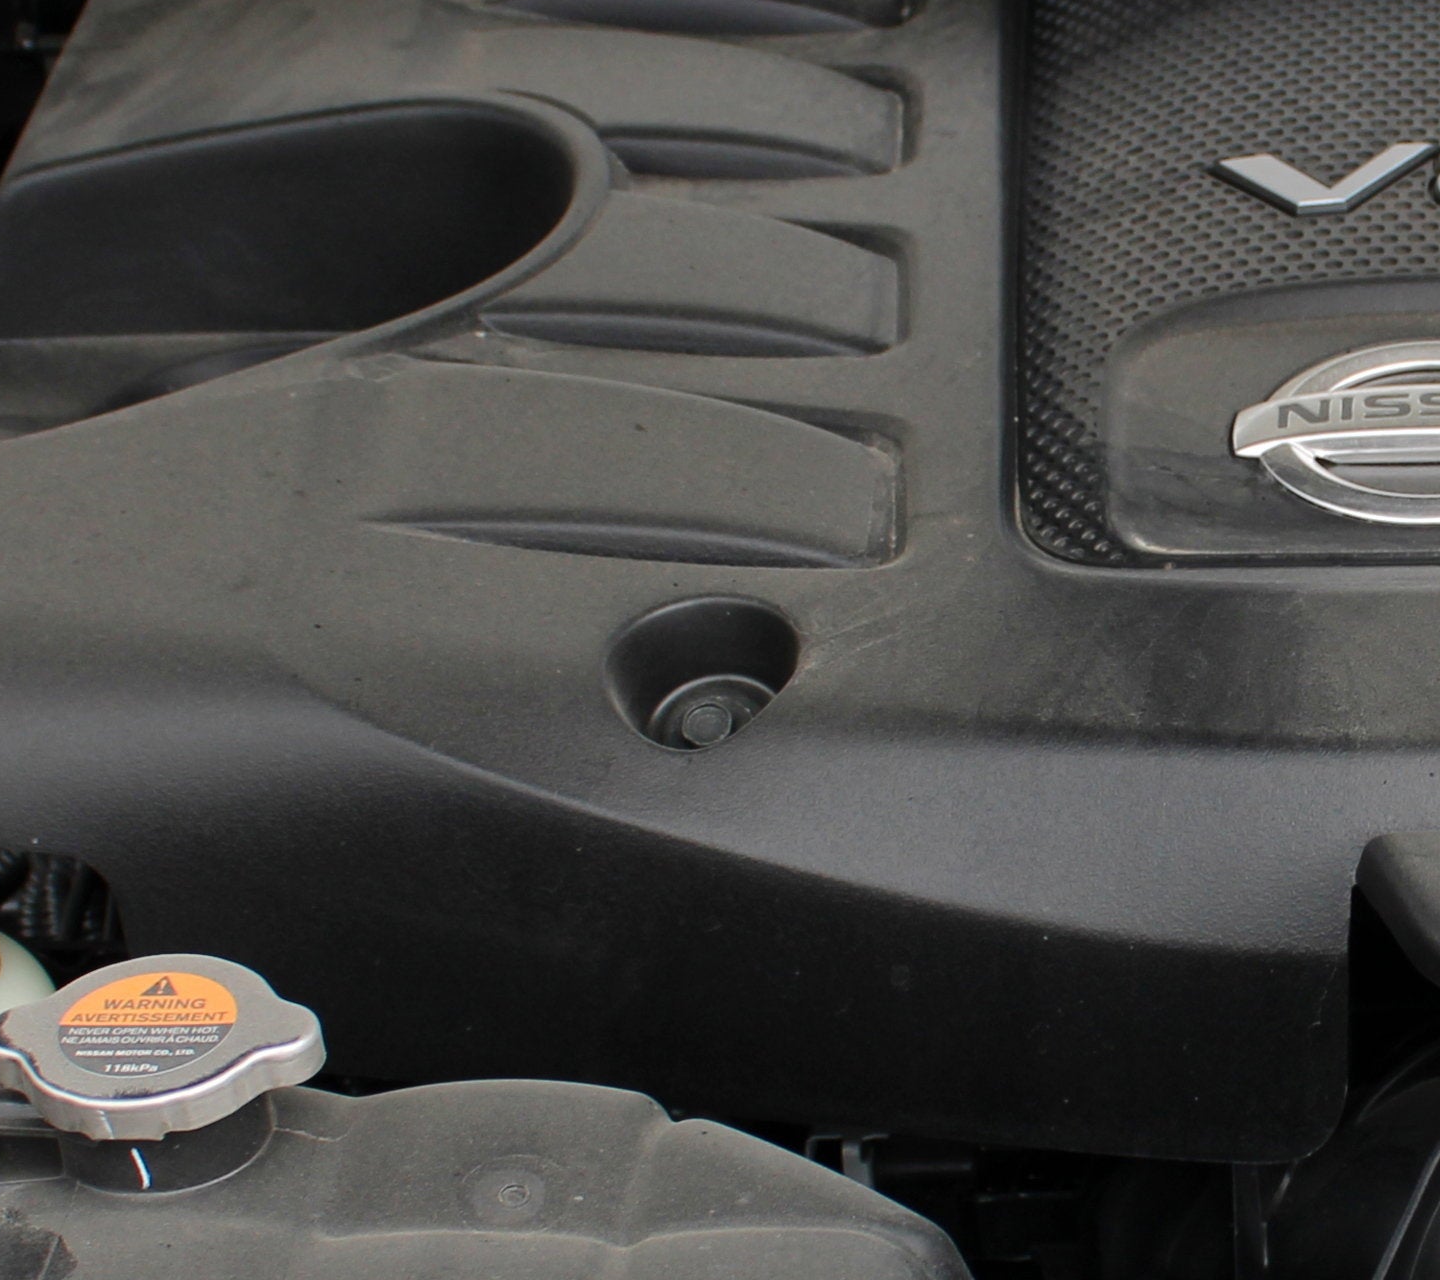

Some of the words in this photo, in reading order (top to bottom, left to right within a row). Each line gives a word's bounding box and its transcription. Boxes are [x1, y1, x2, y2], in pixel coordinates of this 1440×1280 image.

[103, 998, 207, 1010] WARNING
[70, 1011, 229, 1023] AVERTISSEMENT
[68, 1027, 111, 1035] NEVER
[112, 1027, 148, 1035] OPEN
[151, 1026, 190, 1035] WHEN
[61, 1036, 79, 1044] NE
[78, 1036, 120, 1044] JAMAIS
[120, 1035, 166, 1044] OUVRIR
